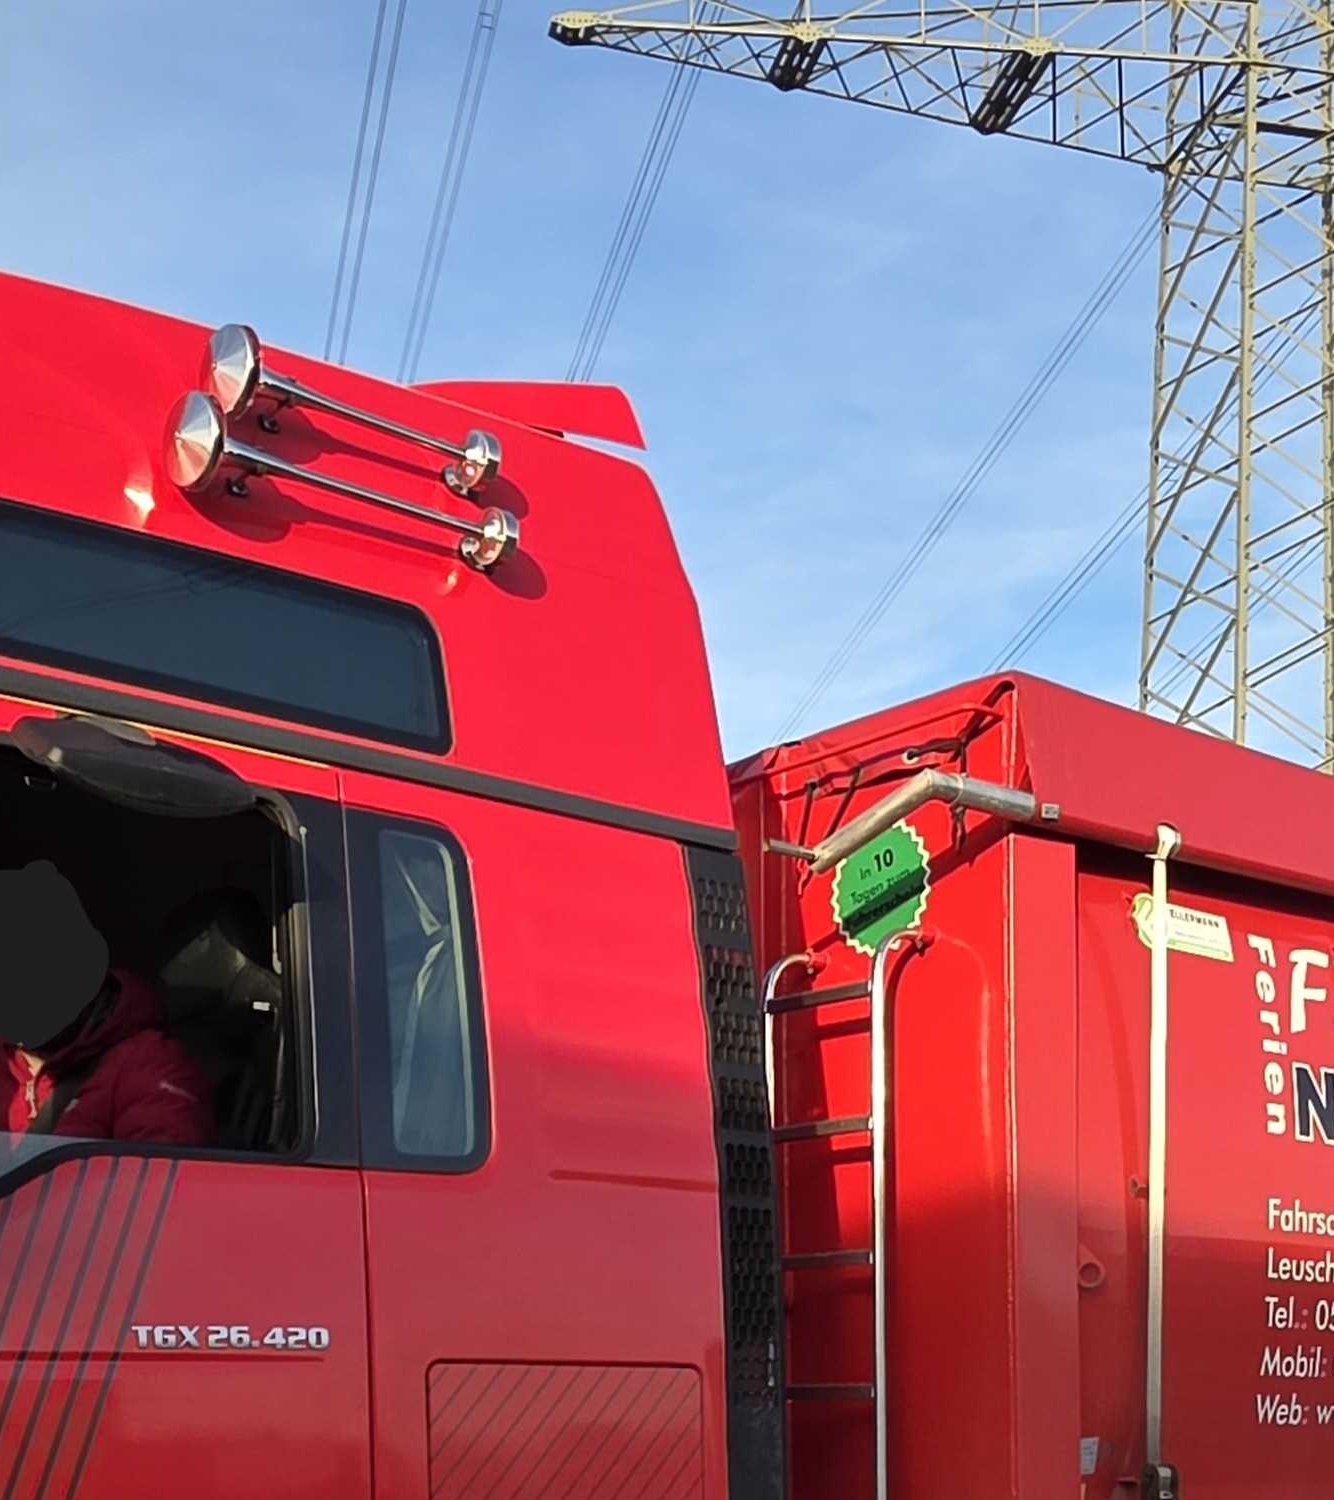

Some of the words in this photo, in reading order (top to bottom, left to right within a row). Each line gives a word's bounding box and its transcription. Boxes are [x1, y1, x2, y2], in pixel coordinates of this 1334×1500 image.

[873, 848, 894, 872] 10
[1246, 933, 1288, 1135] Ferien
[1264, 1296, 1309, 1330] Tel.:
[130, 1325, 201, 1348] TGX
[207, 1325, 330, 1349] 26.420
[1259, 1345, 1328, 1379] Mobil:
[1256, 1393, 1309, 1426] Web:
